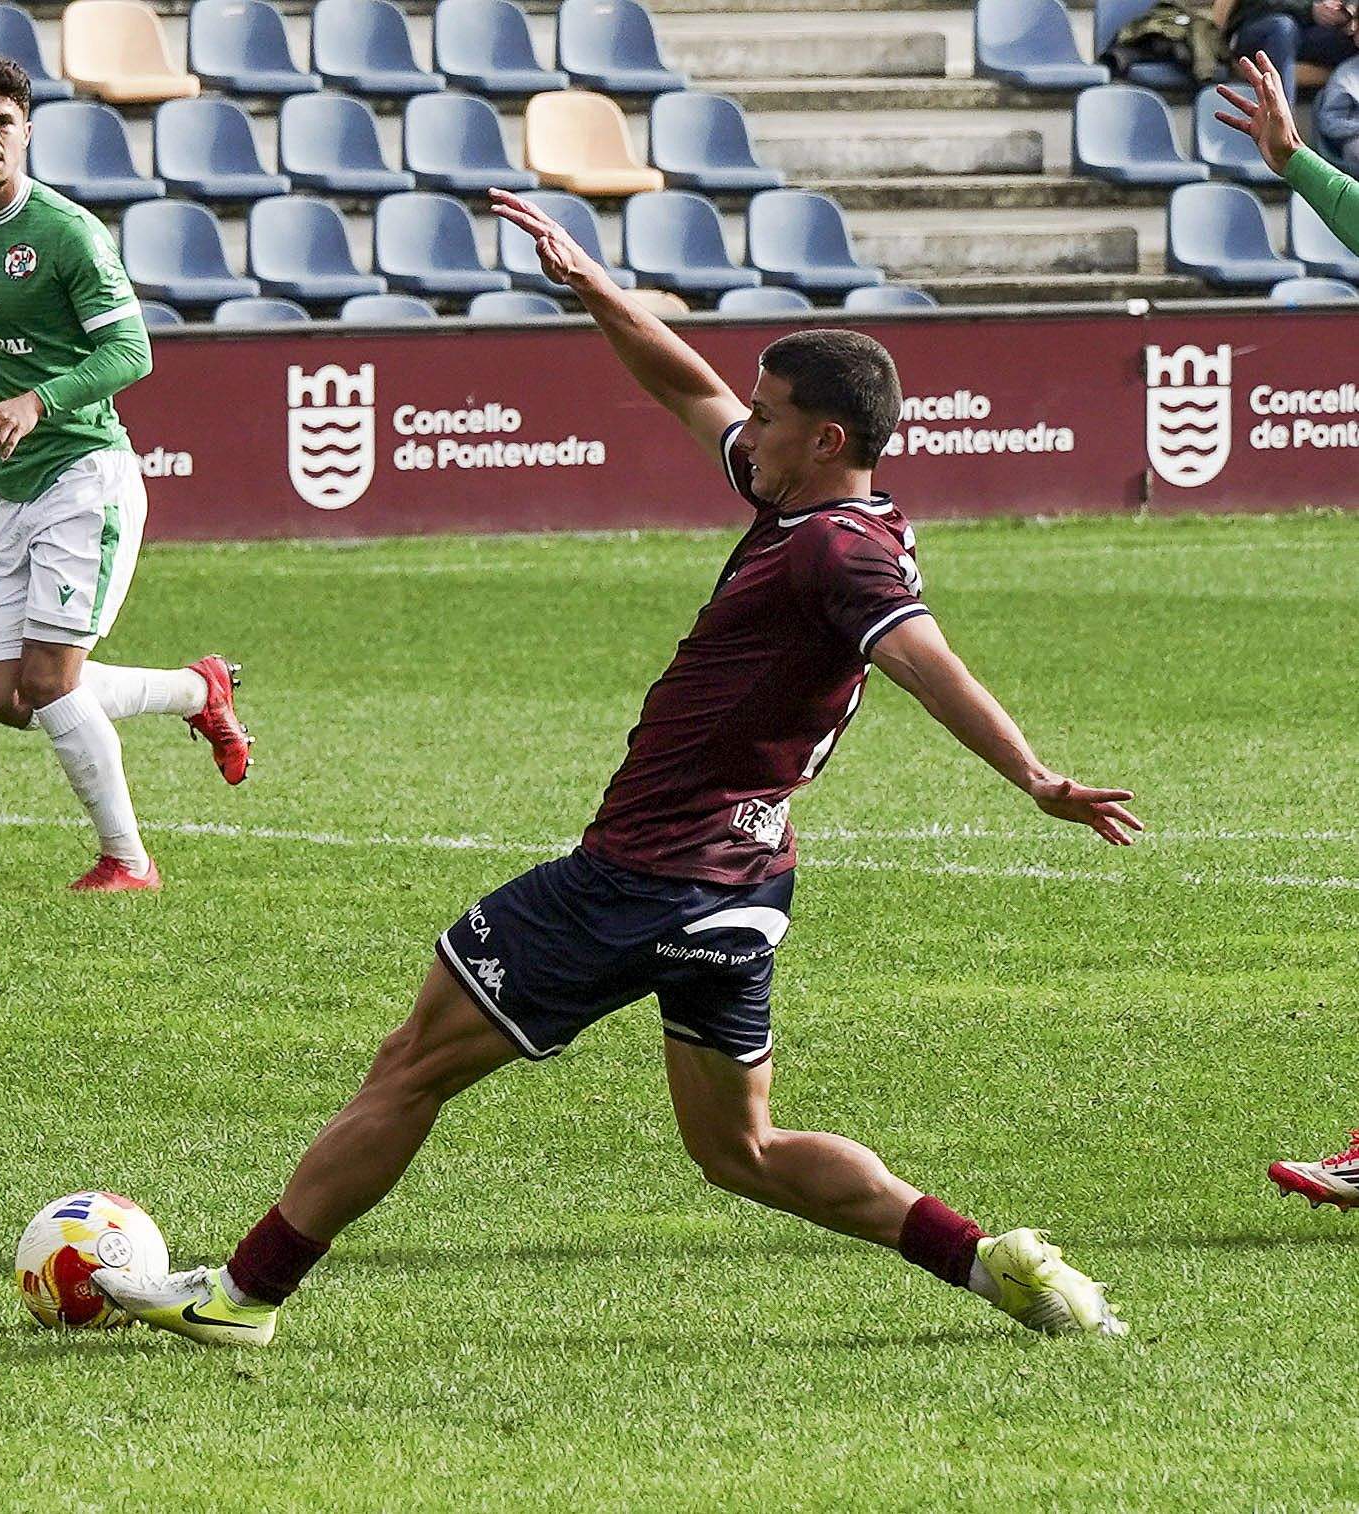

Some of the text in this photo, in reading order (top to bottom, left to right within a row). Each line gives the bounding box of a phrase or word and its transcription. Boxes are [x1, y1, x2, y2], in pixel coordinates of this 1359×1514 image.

[393, 402, 522, 435] Concello
[1249, 418, 1359, 450] de Pont
[393, 434, 606, 470] de Pontevedra
[907, 421, 1074, 456] Pontevedra
